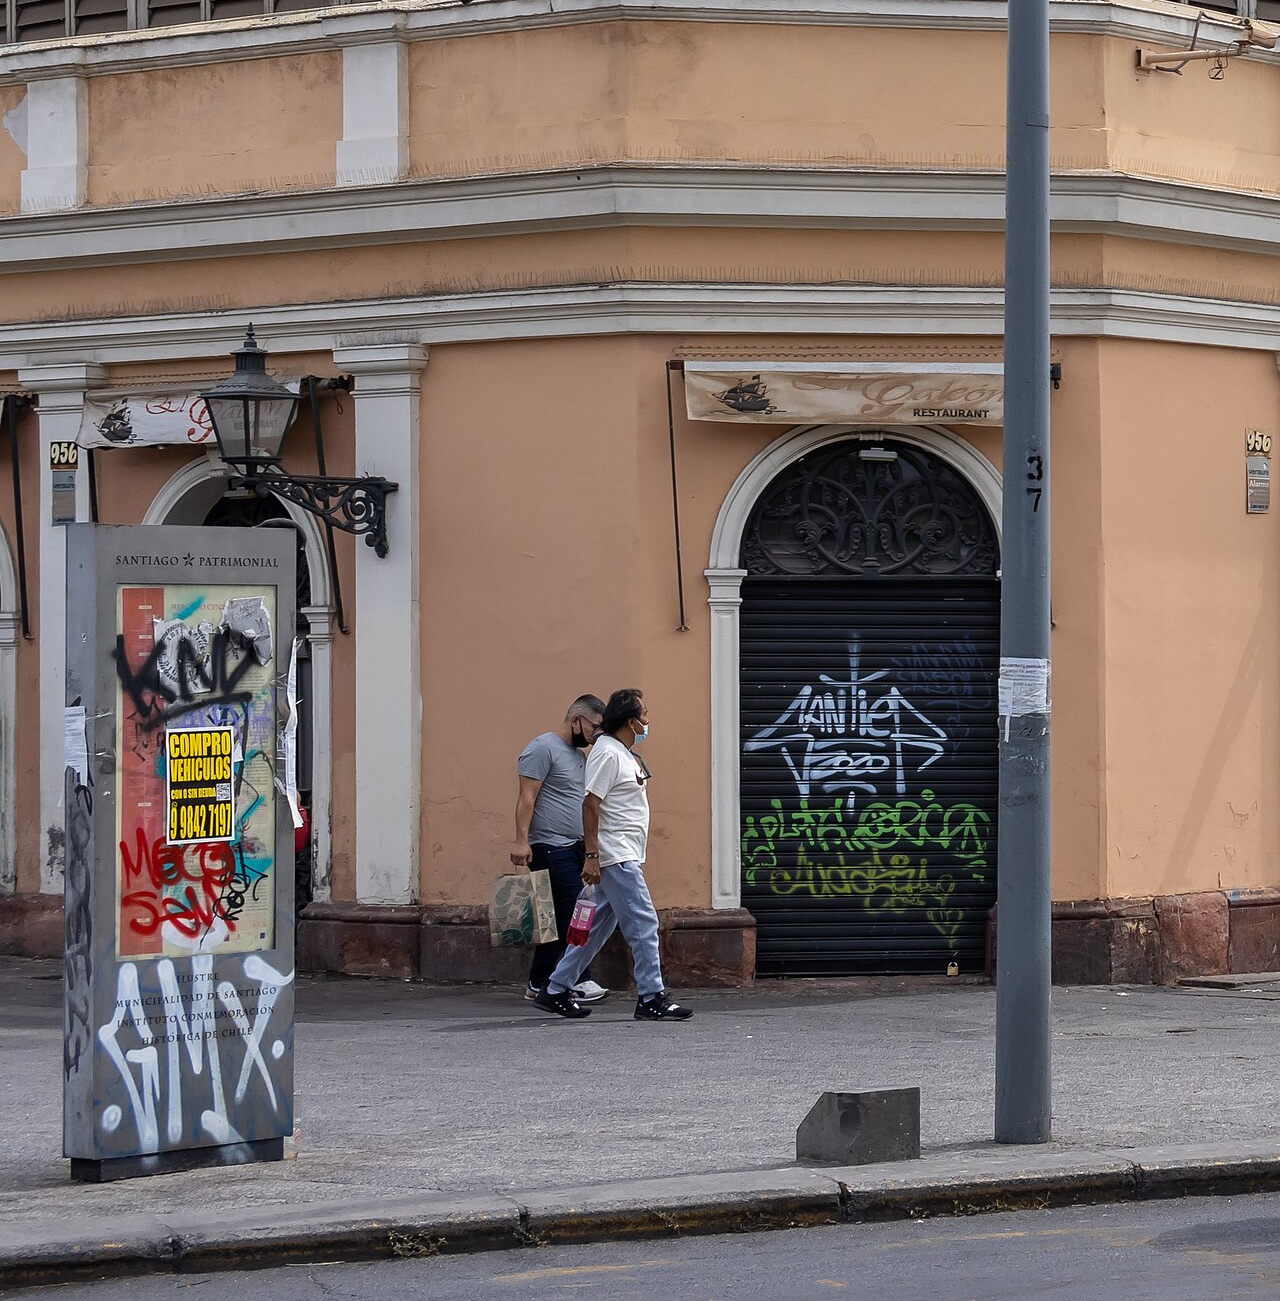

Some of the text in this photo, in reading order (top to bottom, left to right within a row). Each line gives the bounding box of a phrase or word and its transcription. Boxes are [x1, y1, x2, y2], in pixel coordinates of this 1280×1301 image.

[913, 408, 989, 419] RESTAURANT
[1247, 430, 1271, 453] 956
[51, 443, 77, 464] 956
[115, 555, 279, 568] SANTIAGO PATRIMONIAL
[169, 731, 231, 758] COMPRO
[170, 755, 231, 783] VEHICULOS
[170, 786, 216, 800] CON O SIN DEUDA
[170, 803, 231, 840] 9 9842 7197
[176, 972, 219, 984] ILUSTRE
[115, 986, 277, 1008] MUNICIPALIDAD DE SANTIAGO
[117, 1004, 275, 1028] INSTITUTO CONMEMORACIÓN
[142, 1026, 253, 1045] HISTÓRICA DE CHILE
